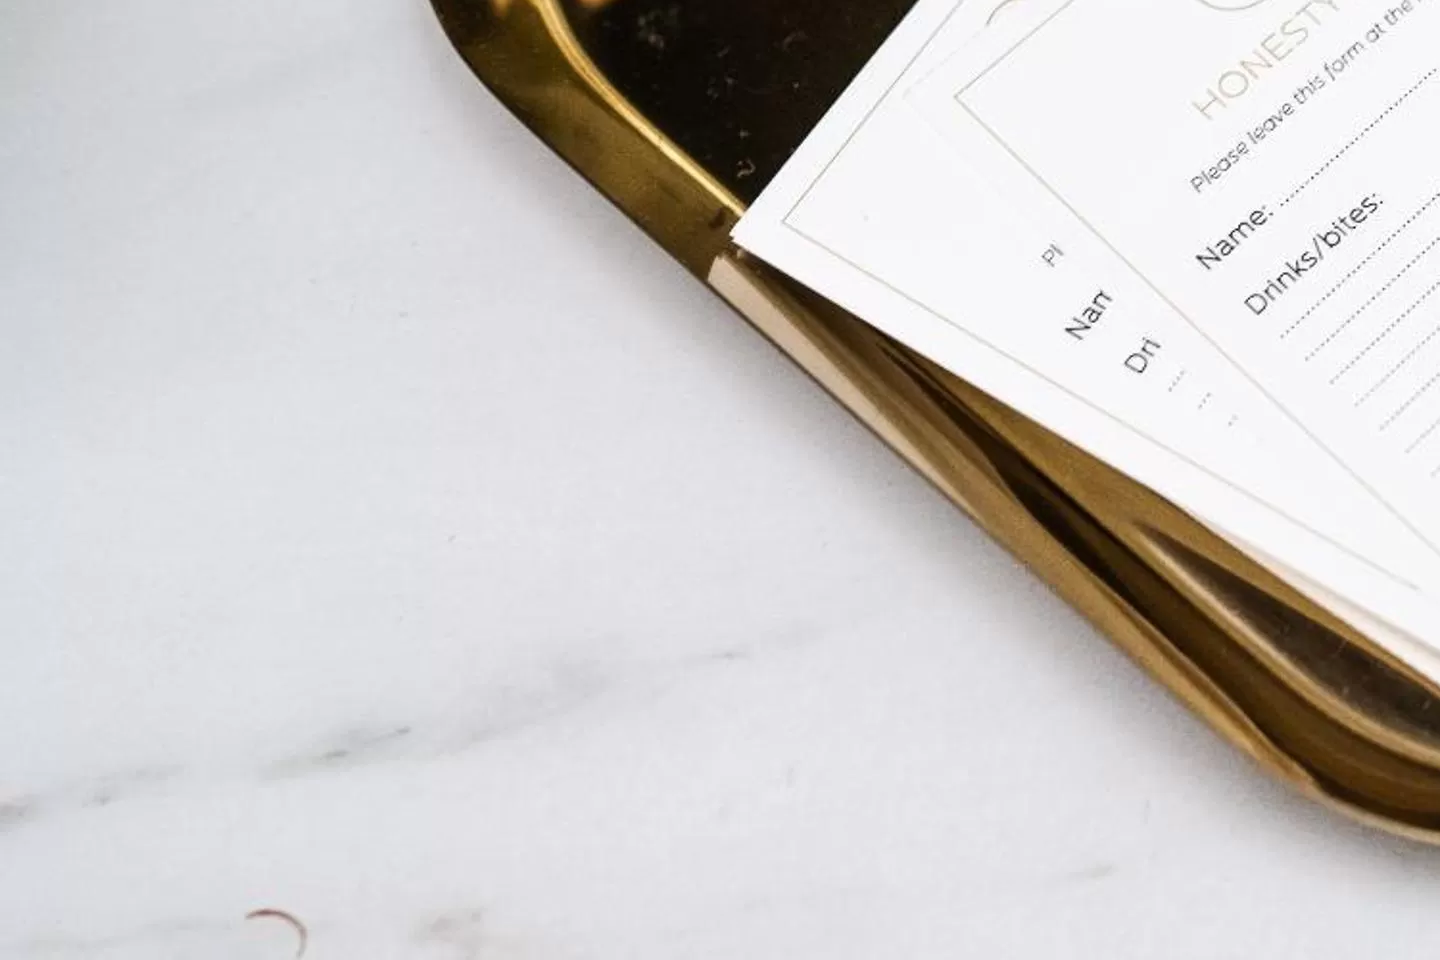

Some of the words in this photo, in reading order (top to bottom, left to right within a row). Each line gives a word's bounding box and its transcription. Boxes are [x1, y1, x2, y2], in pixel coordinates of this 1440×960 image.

[1189, 139, 1249, 194] Please
[1246, 101, 1296, 145] leave
[1292, 73, 1327, 106] this
[1323, 40, 1365, 82] form
[1366, 21, 1388, 45] at
[1194, 204, 1275, 271] Name:
[1243, 192, 1385, 316] Drinks/bites:
